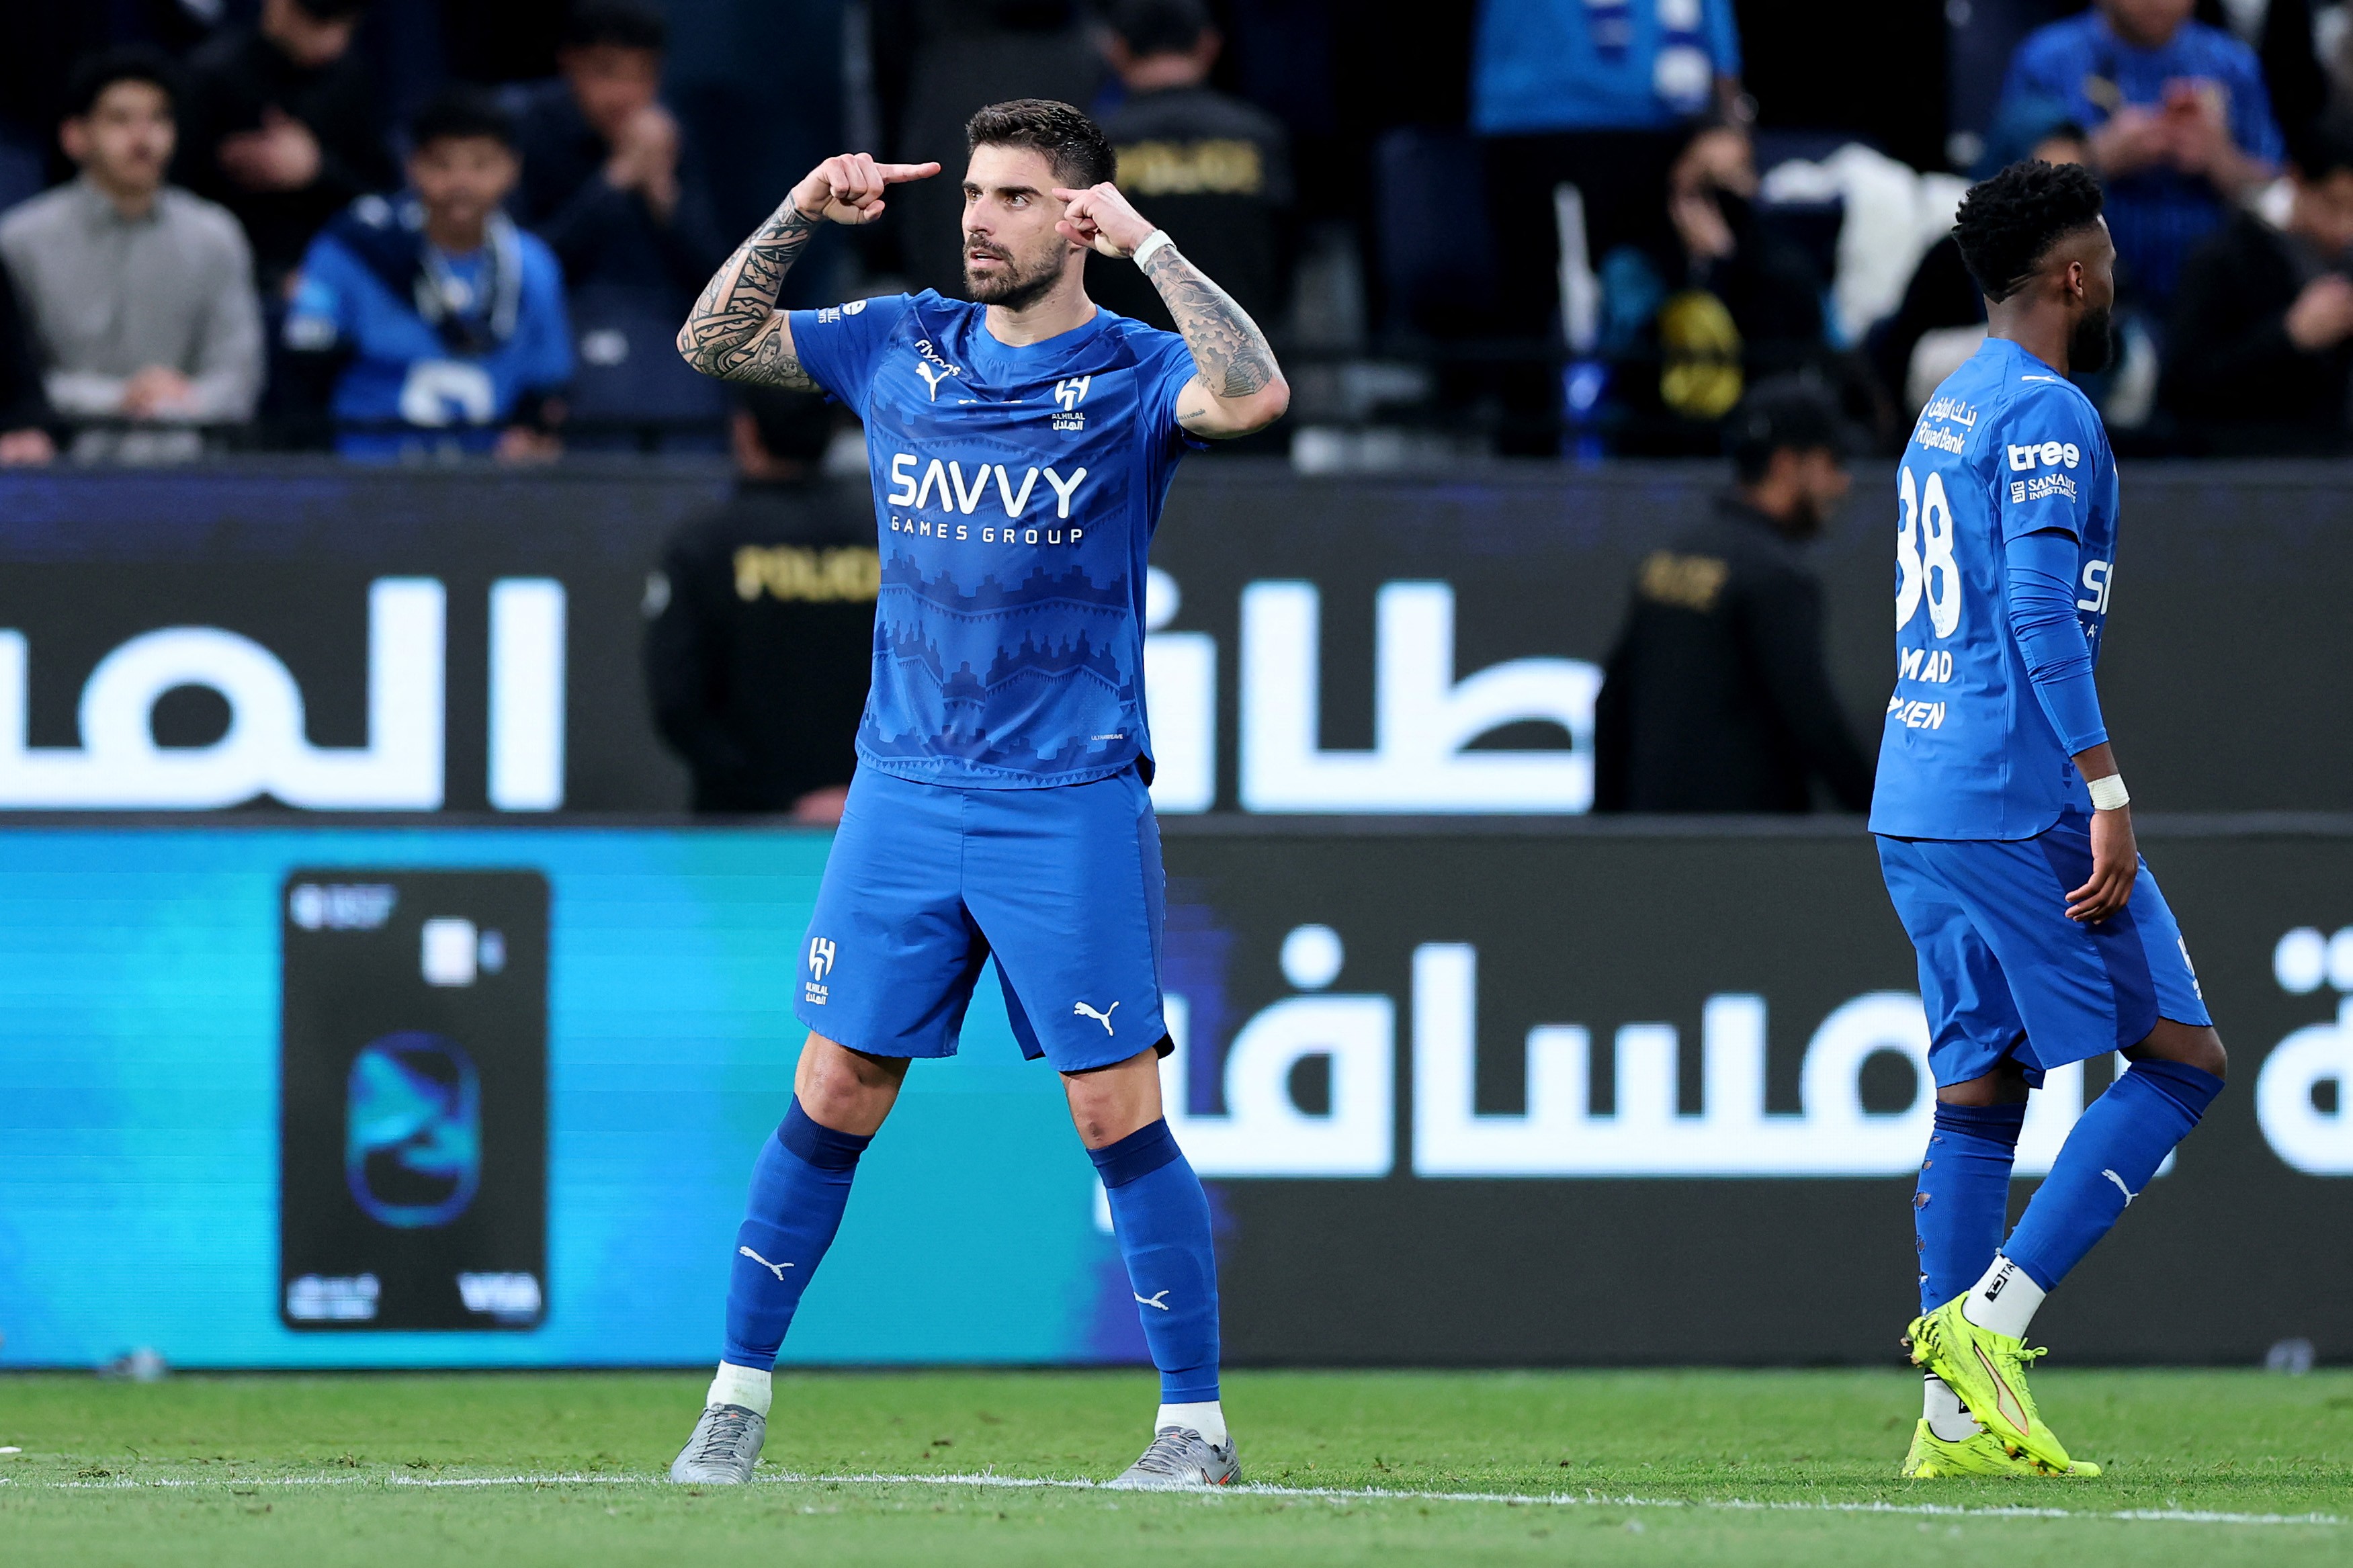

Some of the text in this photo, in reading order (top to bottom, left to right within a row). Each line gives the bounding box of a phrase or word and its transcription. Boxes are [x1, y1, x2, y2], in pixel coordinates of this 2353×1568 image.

[1938, 427, 1965, 455] Bank
[2007, 441, 2080, 472] tree
[888, 453, 1087, 519] SAVVY
[891, 516, 1083, 544] GAMES GROUP
[1898, 646, 1953, 683] MAD
